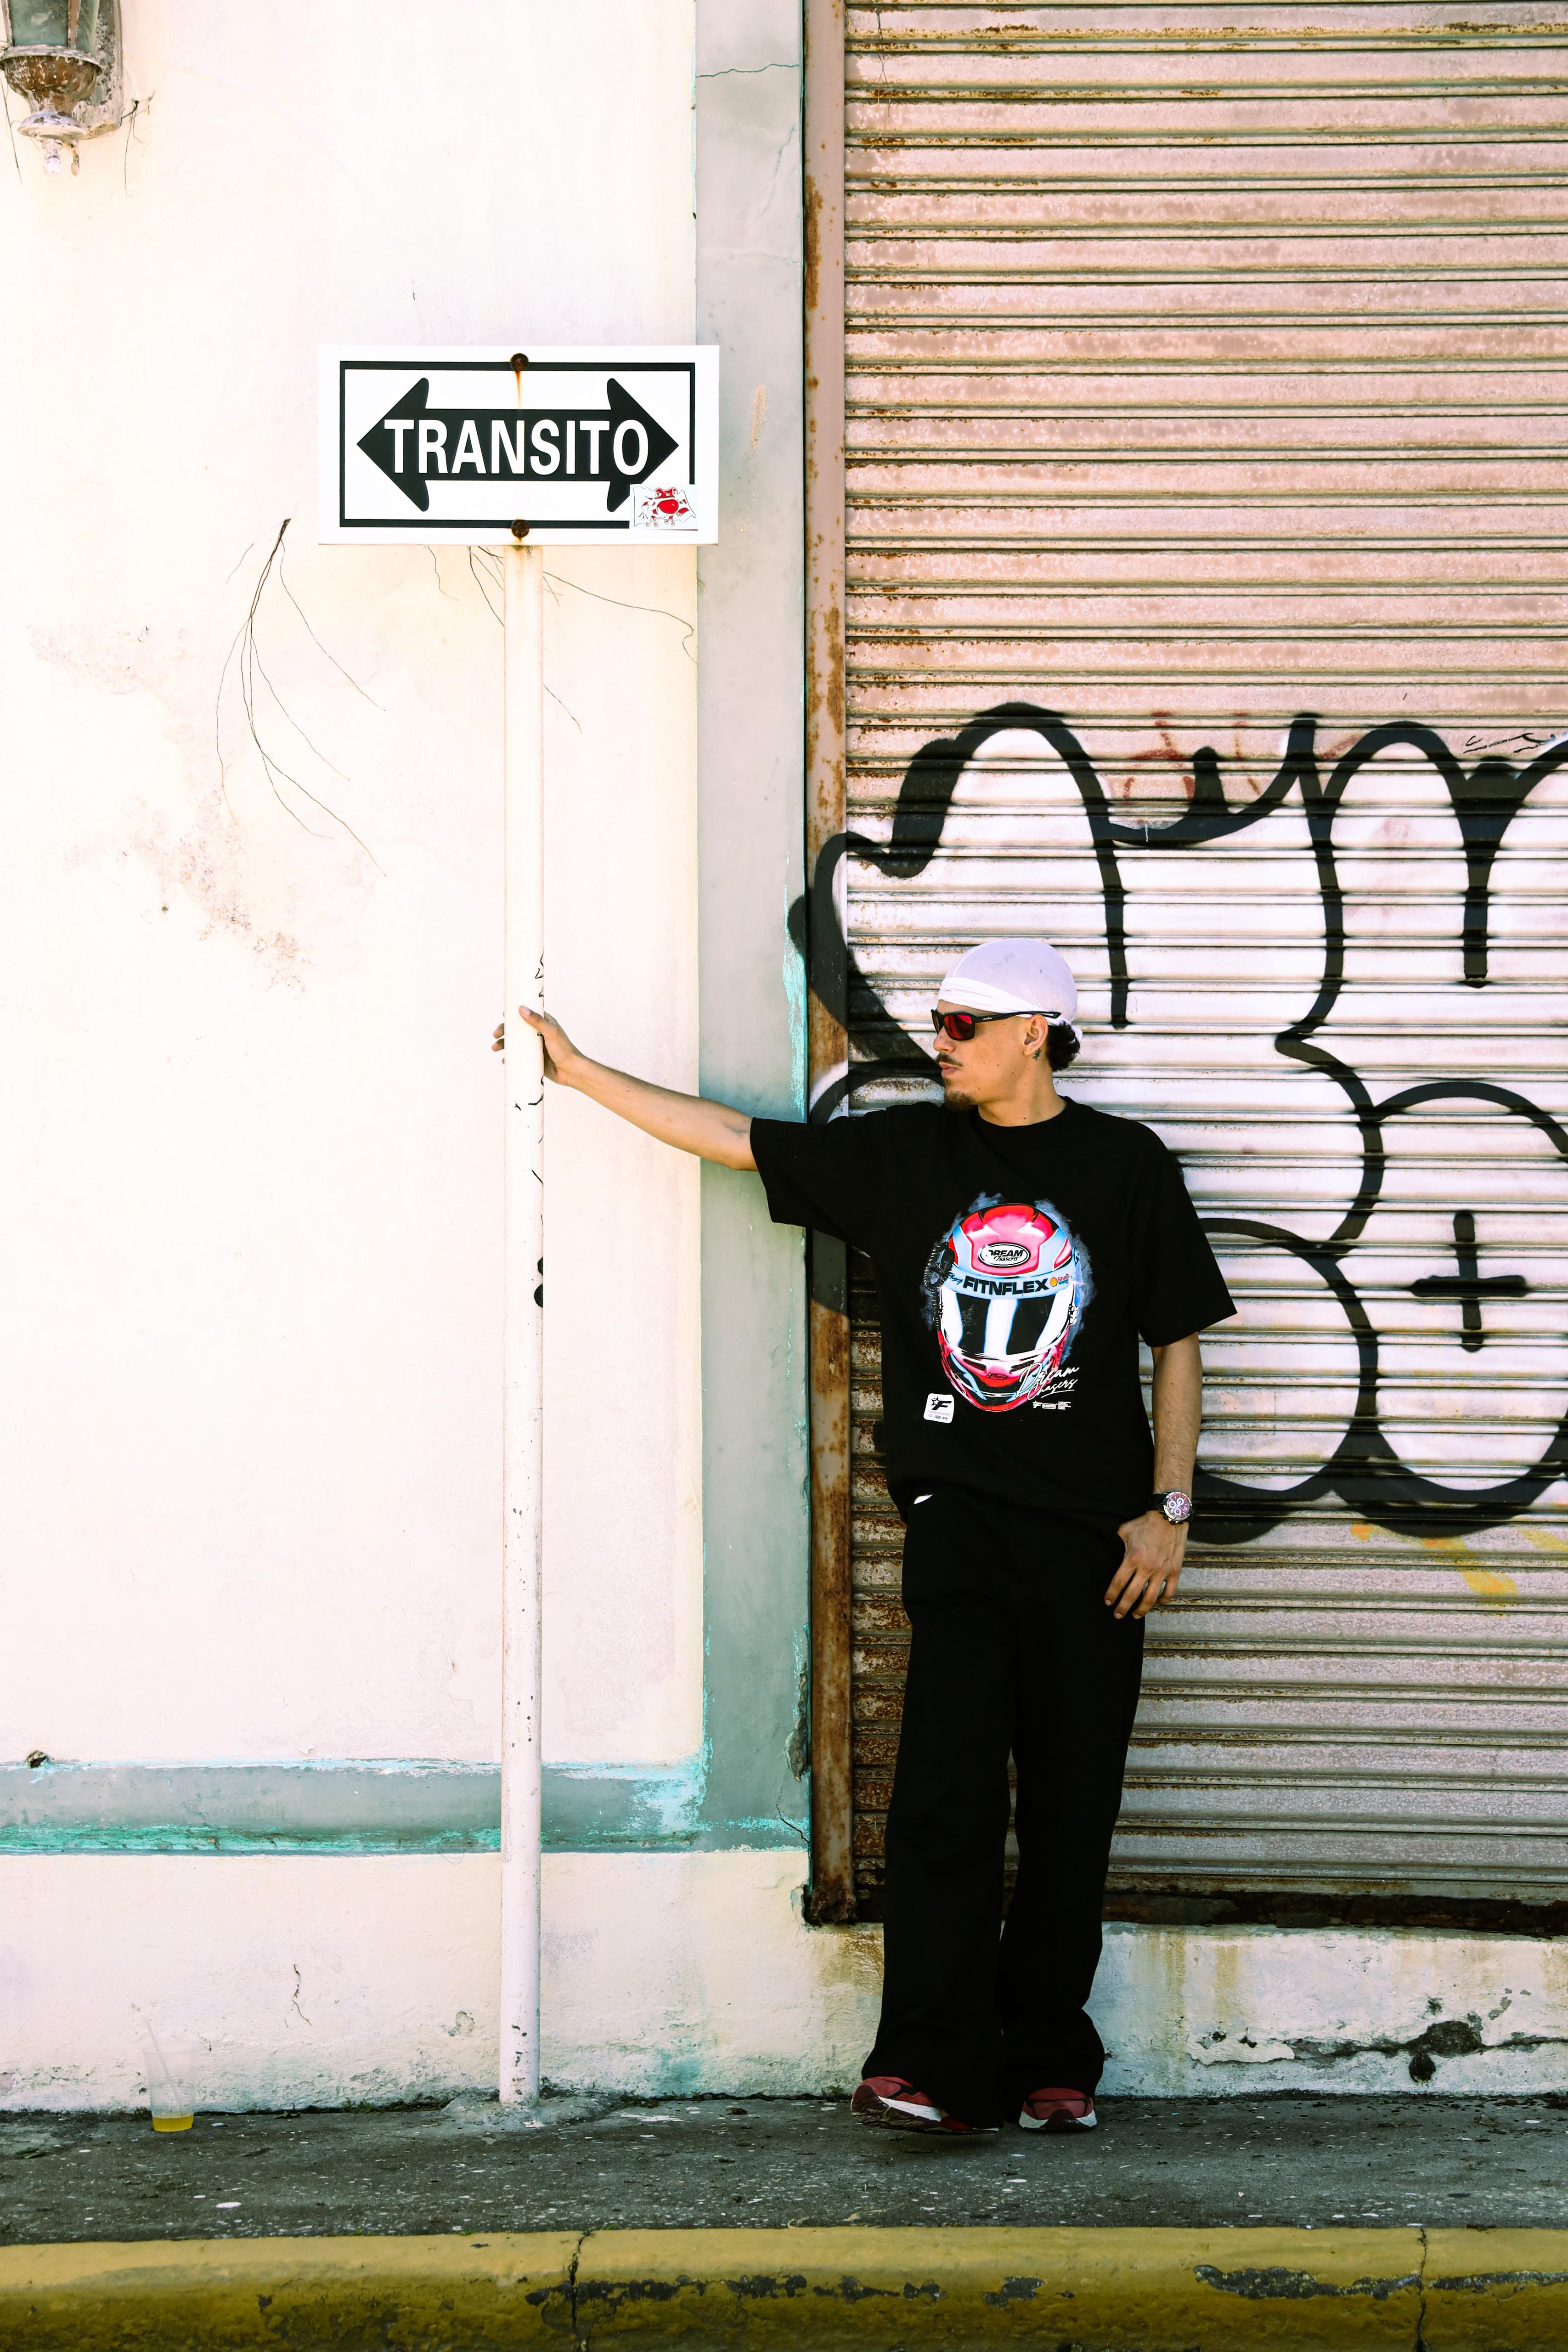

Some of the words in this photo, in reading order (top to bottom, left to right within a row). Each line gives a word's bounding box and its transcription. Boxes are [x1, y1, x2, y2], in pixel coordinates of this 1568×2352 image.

[384, 419, 649, 475] TRANSITO
[963, 1276, 1049, 1295] FITNFLEX
[1015, 1362, 1080, 1398] Dream
[1027, 1379, 1078, 1400] Chasers
